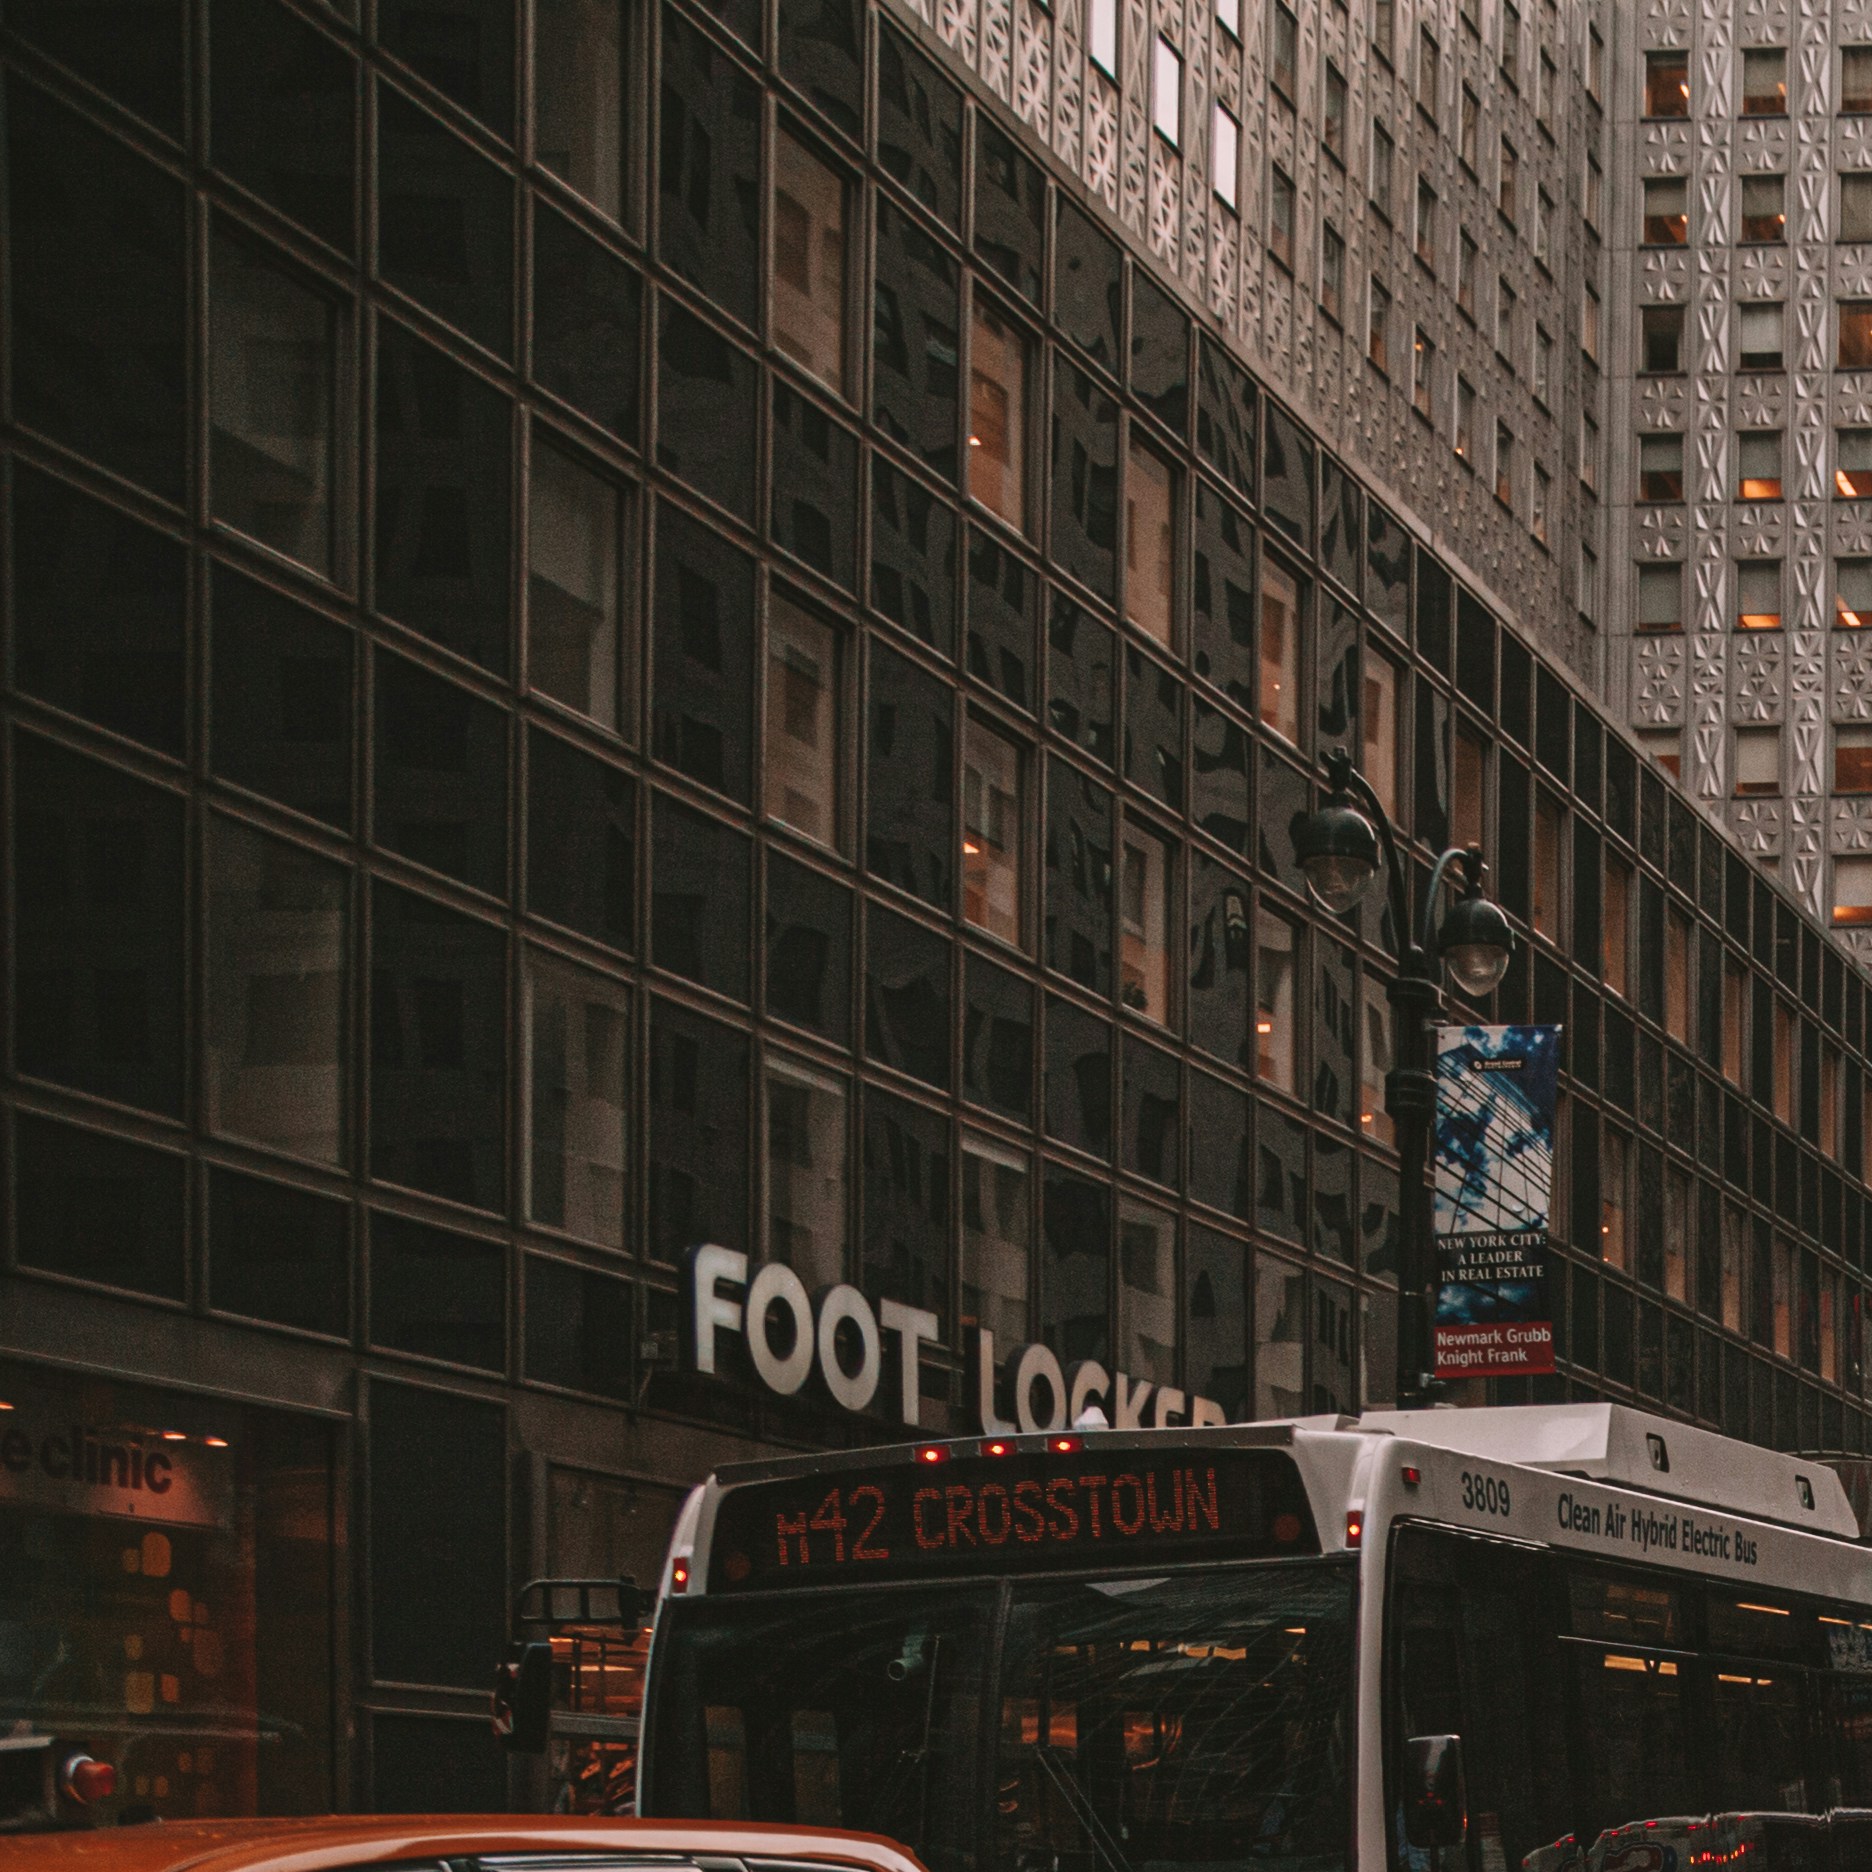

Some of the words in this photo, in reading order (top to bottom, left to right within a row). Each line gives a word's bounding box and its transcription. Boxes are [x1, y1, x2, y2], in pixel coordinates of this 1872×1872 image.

[1438, 1236, 1466, 1250] NEW
[1469, 1234, 1506, 1248] YORK
[1510, 1232, 1547, 1246] CITY:
[1458, 1254, 1466, 1265] A
[1470, 1250, 1523, 1264] LEADER
[1441, 1270, 1455, 1282] IN
[1459, 1267, 1492, 1281] REAL
[1496, 1265, 1544, 1278] ESTATE
[695, 1243, 938, 1426] FOOT
[1437, 1329, 1503, 1346] Newmark
[1506, 1327, 1551, 1343] Grubb
[1437, 1349, 1484, 1367] Knight
[1487, 1347, 1528, 1363] Frank
[40, 1424, 173, 1494] clinic
[913, 1467, 1219, 1551] CROSSTOWN
[1461, 1471, 1511, 1517] 3809
[1557, 1493, 1600, 1535] Clean
[1605, 1503, 1626, 1539] Air
[1631, 1509, 1677, 1552] Hybrid
[1682, 1517, 1730, 1560] Electric
[1735, 1531, 1757, 1565] Bus
